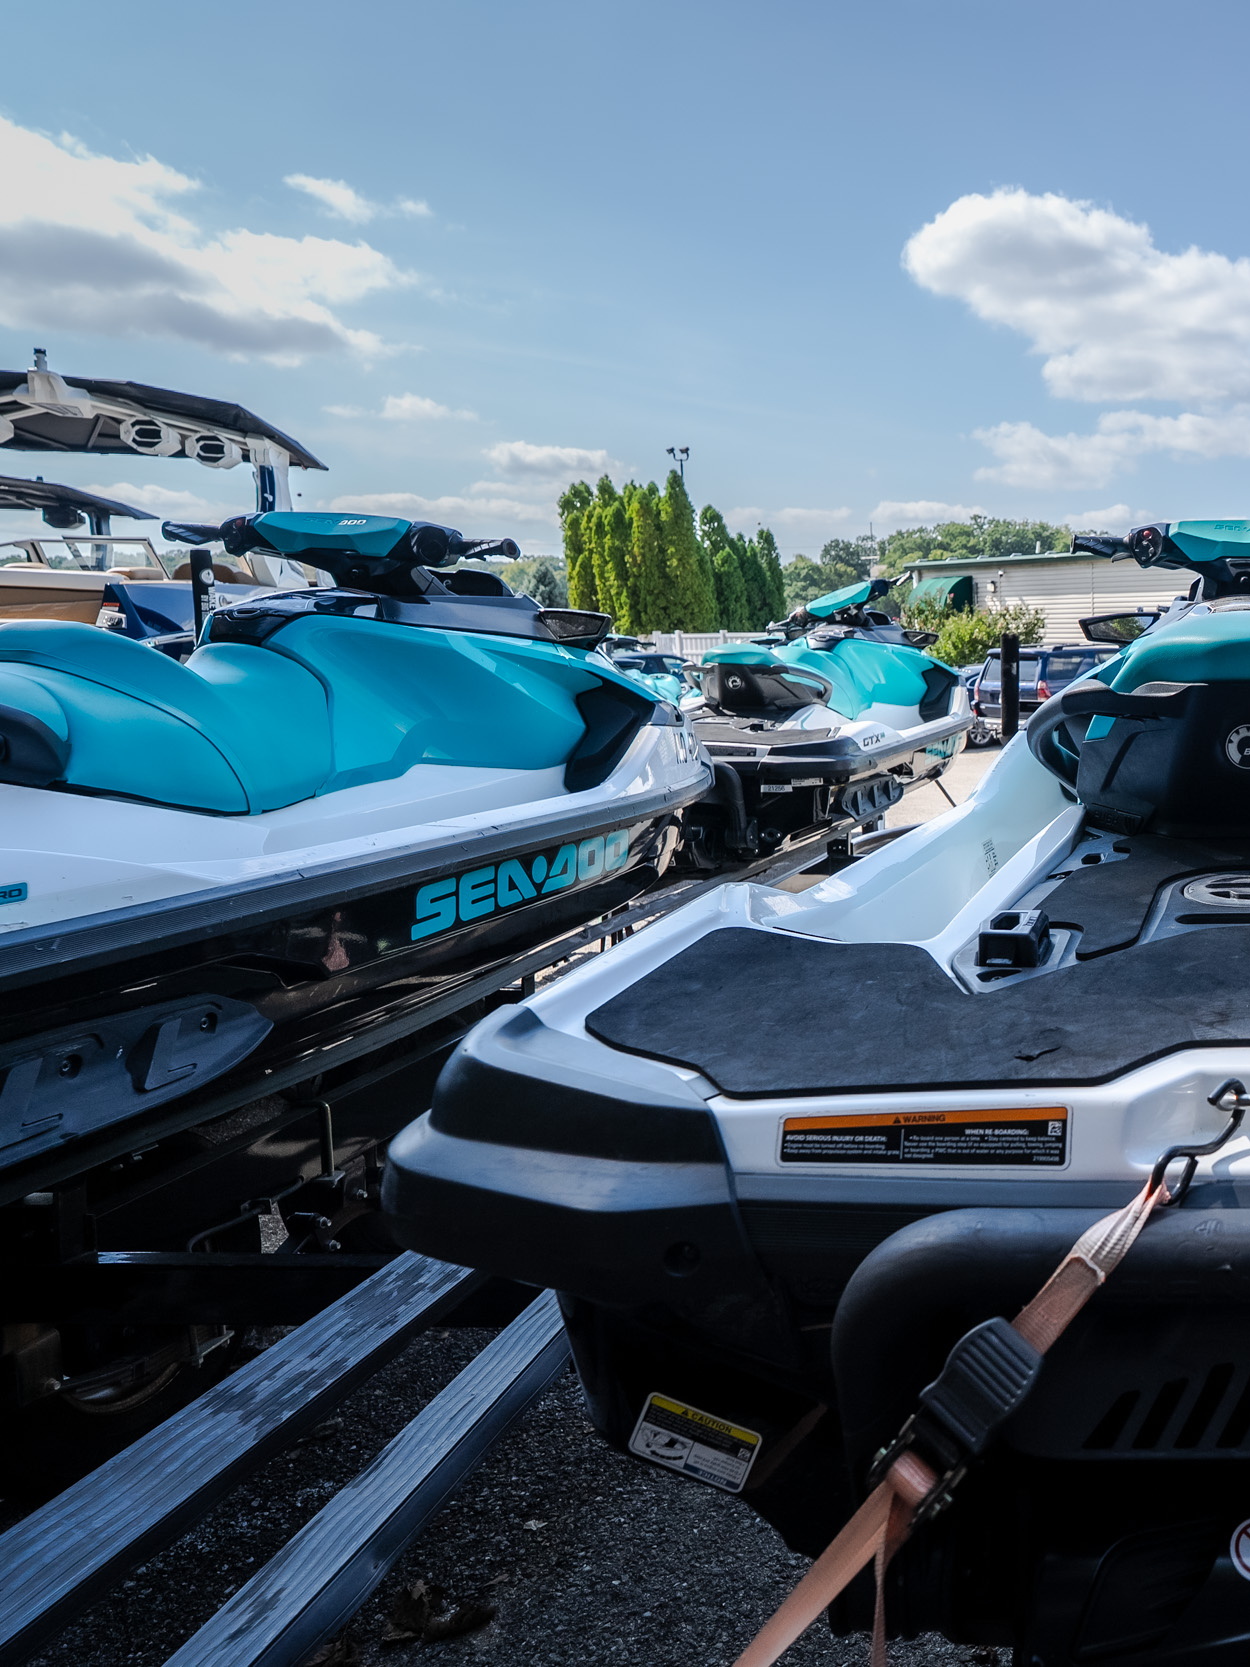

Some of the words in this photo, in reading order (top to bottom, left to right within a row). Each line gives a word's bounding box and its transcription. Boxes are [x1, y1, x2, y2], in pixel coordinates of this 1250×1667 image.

[863, 733, 880, 747] GTX
[903, 1114, 946, 1123] WARNING
[692, 1412, 732, 1433] CAUTION
